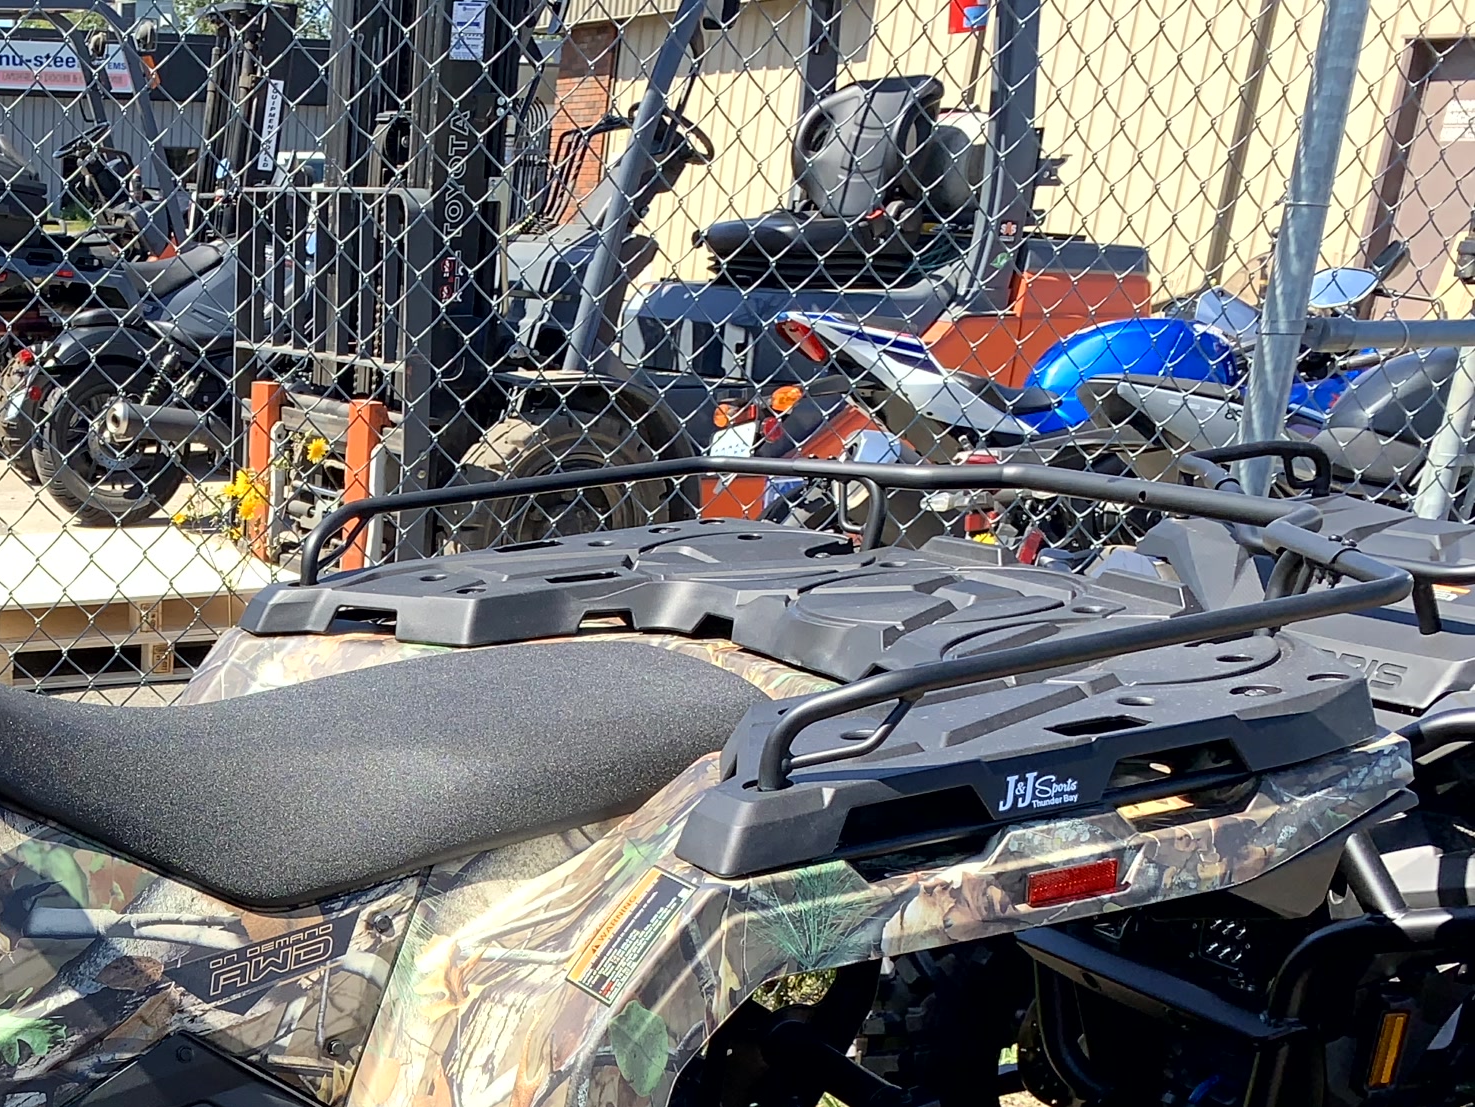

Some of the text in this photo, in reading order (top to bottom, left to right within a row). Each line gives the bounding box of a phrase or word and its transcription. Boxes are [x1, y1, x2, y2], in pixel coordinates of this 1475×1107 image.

[444, 110, 471, 238] TOYOTA
[1031, 793, 1079, 809] Thunder Bay
[1035, 775, 1078, 797] Sports
[598, 895, 637, 942] WARNING
[210, 924, 333, 969] ON DEMAND
[210, 935, 333, 996] AWD
